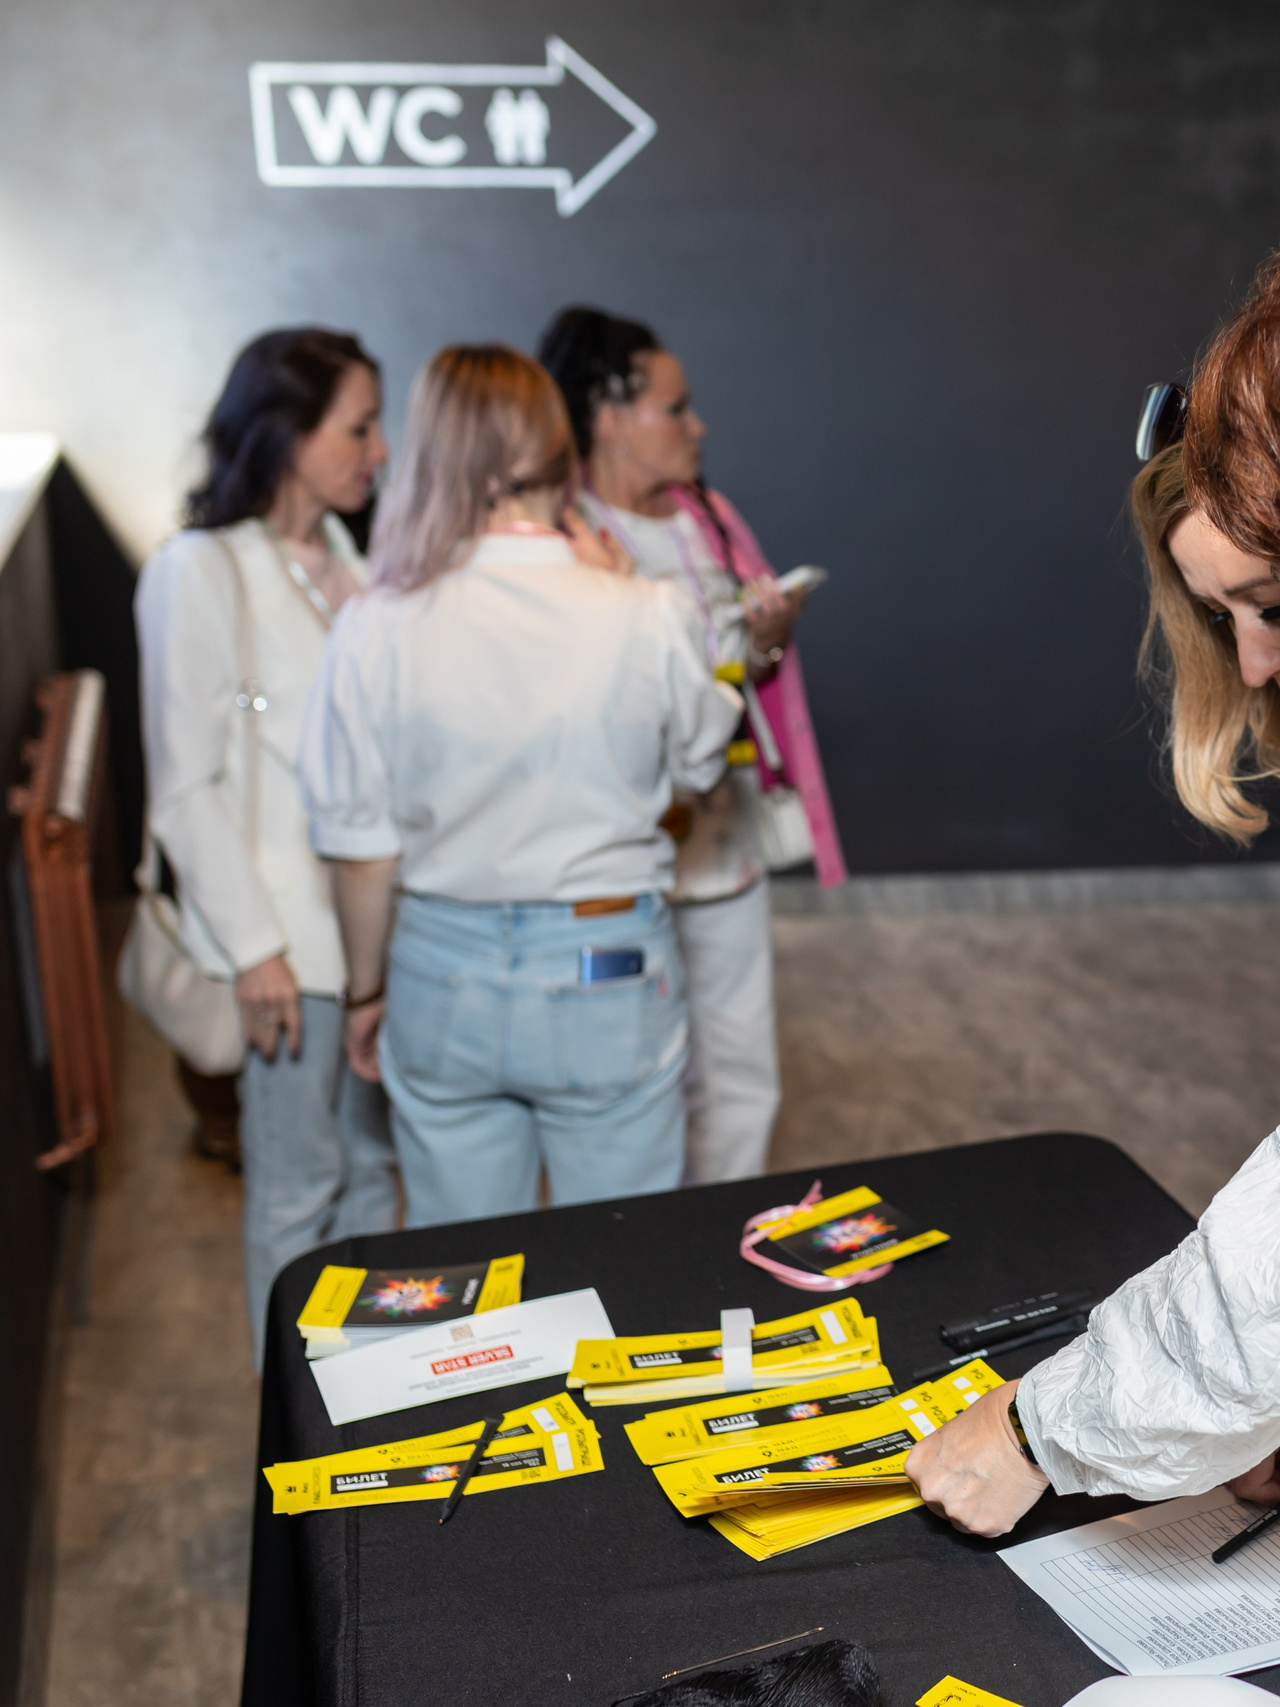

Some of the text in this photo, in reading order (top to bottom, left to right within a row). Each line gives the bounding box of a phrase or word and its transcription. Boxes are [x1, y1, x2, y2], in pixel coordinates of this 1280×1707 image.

[287, 85, 467, 166] WC
[467, 1345, 512, 1367] SILVER
[633, 1351, 680, 1363] БИЛЕТ
[433, 1356, 468, 1374] STAR
[708, 1412, 756, 1428] БИЛЕТ
[336, 1472, 388, 1485] БИЛЕТ
[722, 1467, 769, 1484] БИЛЕТ
